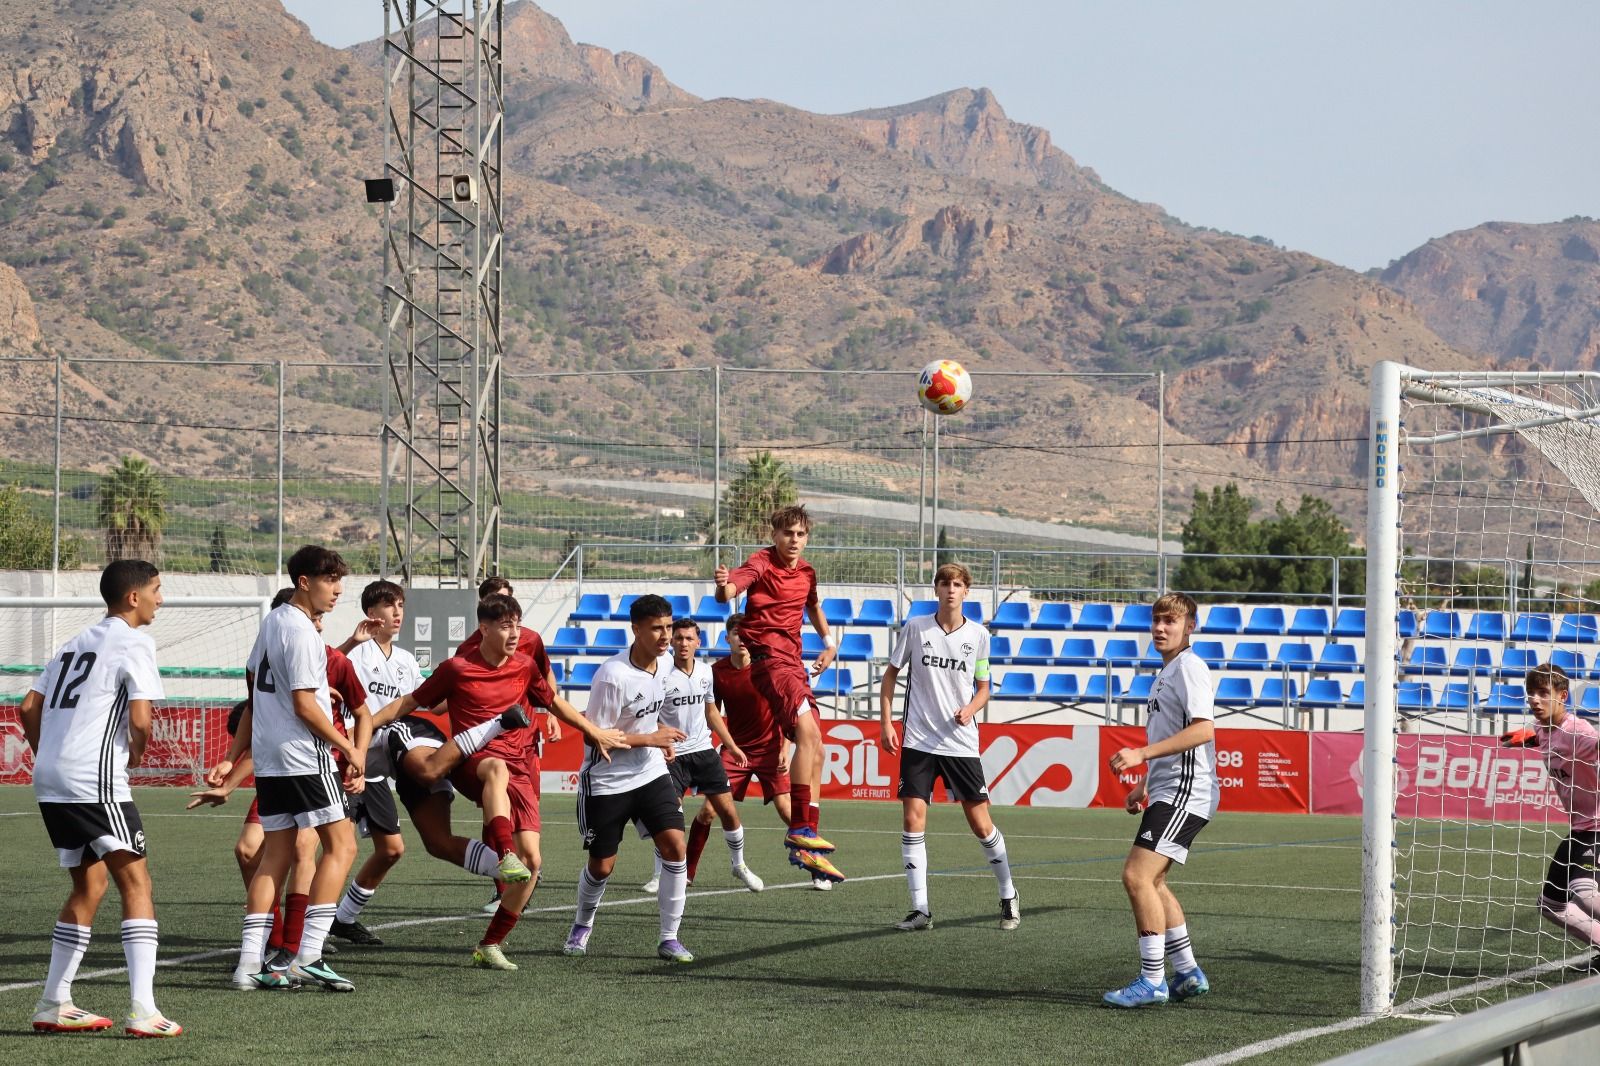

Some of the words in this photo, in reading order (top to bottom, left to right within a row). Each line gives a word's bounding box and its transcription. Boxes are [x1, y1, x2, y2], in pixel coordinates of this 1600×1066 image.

[1376, 433, 1388, 489] MONDO
[921, 654, 967, 672] CEUTA
[49, 651, 97, 709] 12
[368, 681, 402, 699] CEUTA
[852, 788, 868, 798] SAFE
[869, 789, 891, 798] FRUITS
